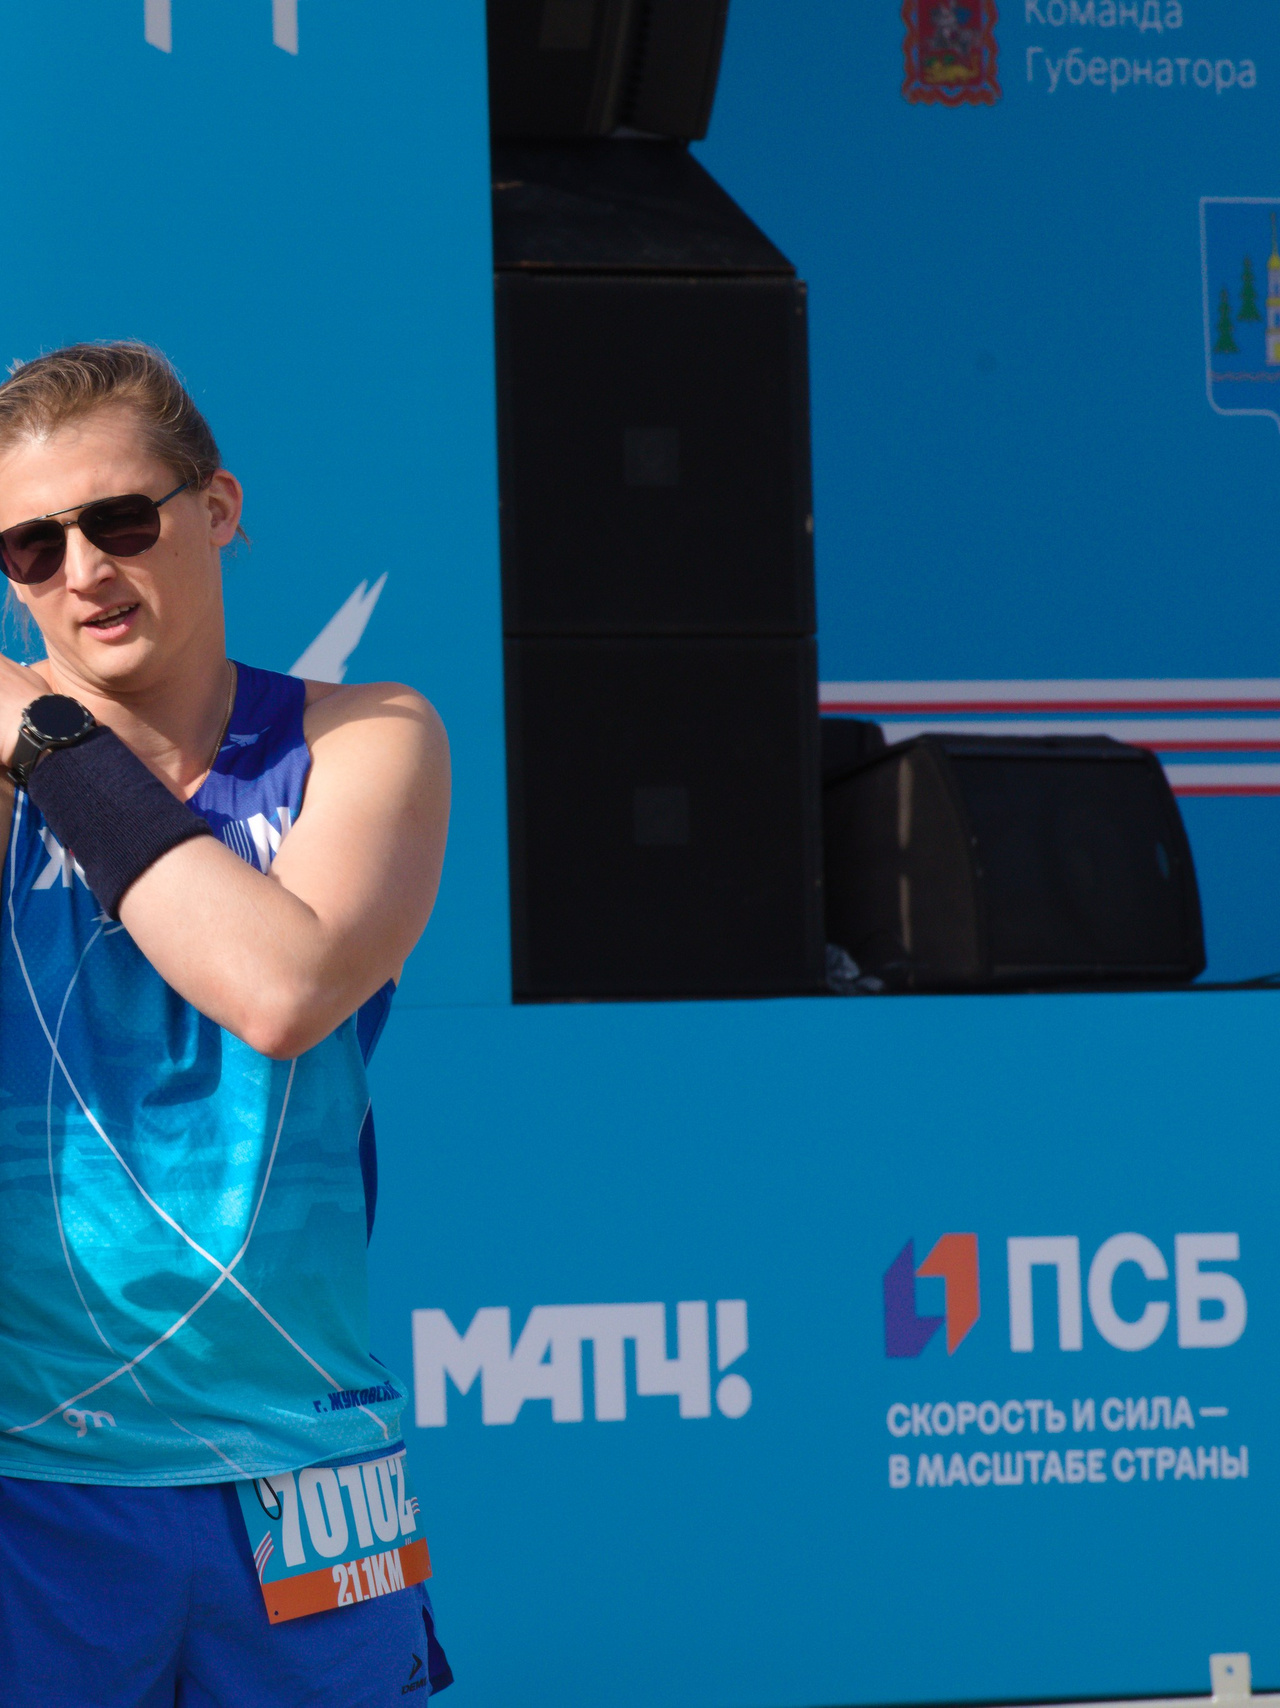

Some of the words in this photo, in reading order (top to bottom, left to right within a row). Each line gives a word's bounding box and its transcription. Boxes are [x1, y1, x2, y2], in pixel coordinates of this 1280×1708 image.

[1024, 0, 1184, 34] Команда
[1026, 46, 1257, 95] Губернатора
[1007, 1232, 1248, 1353] ПСБ
[411, 1299, 752, 1428] МАТЧ!
[886, 1399, 1067, 1437] СКОРОСТЬ
[1072, 1398, 1096, 1433] И
[1101, 1396, 1195, 1432] СИЛА
[888, 1453, 911, 1489] В
[916, 1448, 1108, 1488] МАСШТАБЕ
[1112, 1445, 1250, 1483] СТРАНЫ
[260, 1456, 417, 1568] 70102
